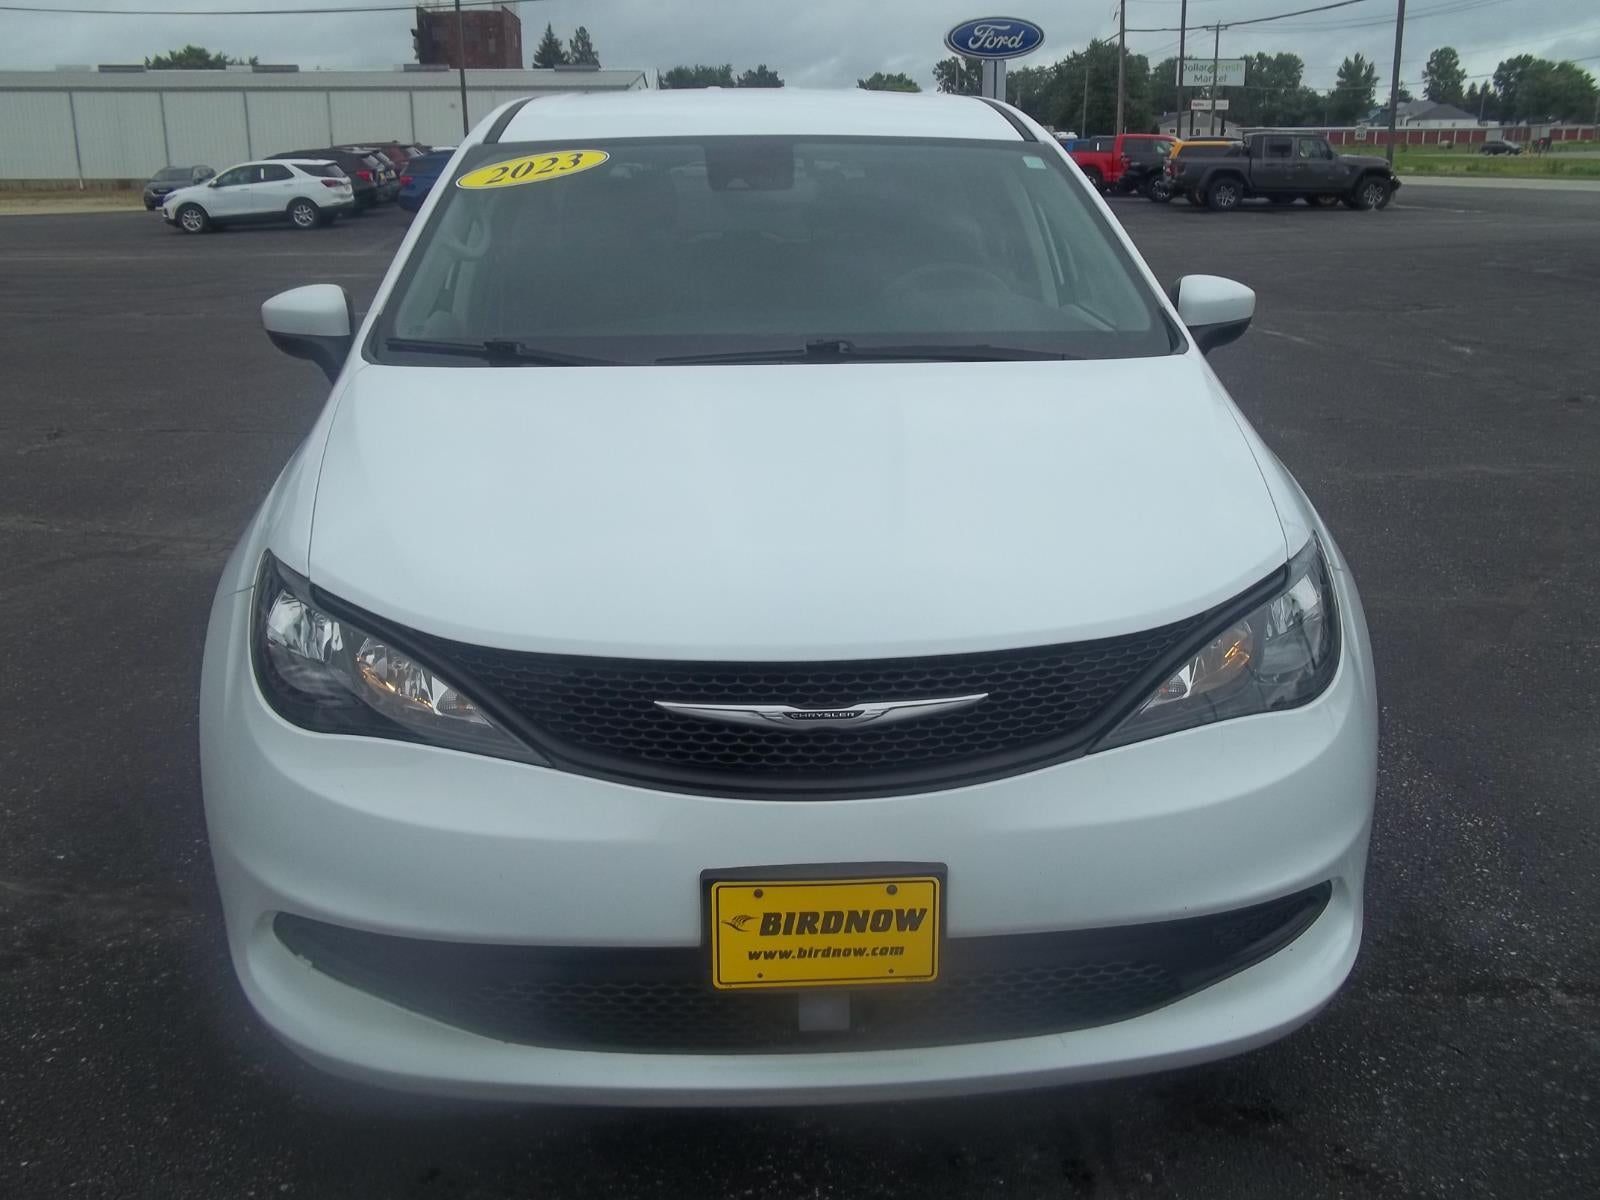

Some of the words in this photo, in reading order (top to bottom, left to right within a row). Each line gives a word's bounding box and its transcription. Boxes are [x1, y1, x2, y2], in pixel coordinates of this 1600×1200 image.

[968, 24, 1025, 49] Ford
[1193, 73, 1227, 83] Maret
[484, 152, 584, 185] 2023
[759, 908, 928, 936] BIRDNOW
[747, 945, 905, 961] www.birdnow.com
